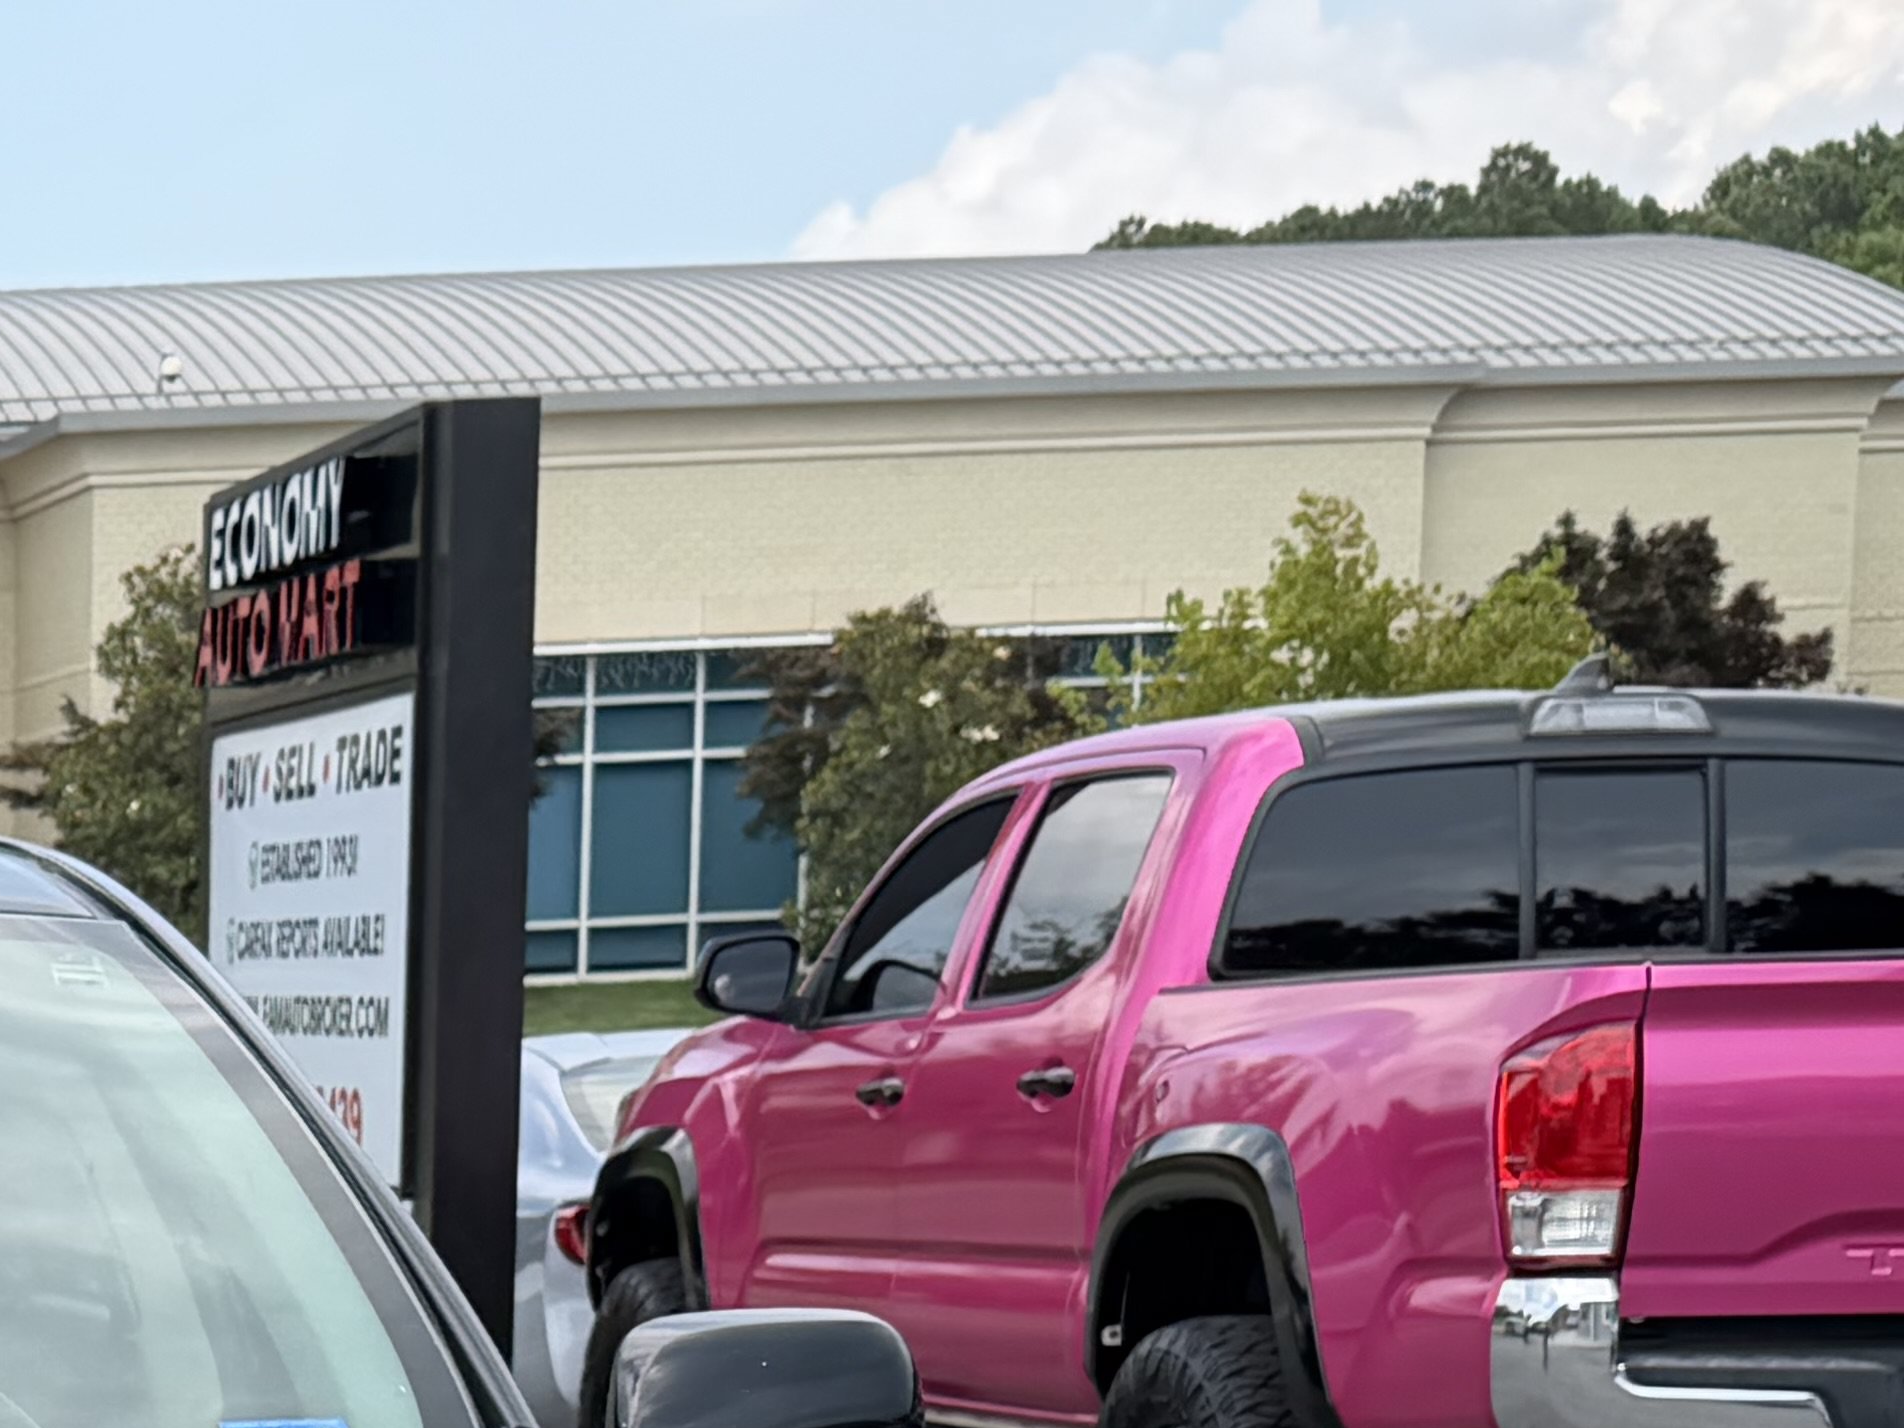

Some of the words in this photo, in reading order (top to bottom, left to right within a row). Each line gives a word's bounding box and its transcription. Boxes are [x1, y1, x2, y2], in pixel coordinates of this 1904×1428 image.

[209, 456, 346, 590] ECONOMY
[194, 588, 272, 688] AUTO
[225, 752, 261, 811] BUY
[272, 741, 316, 804] SELL
[335, 724, 404, 795] TRADE
